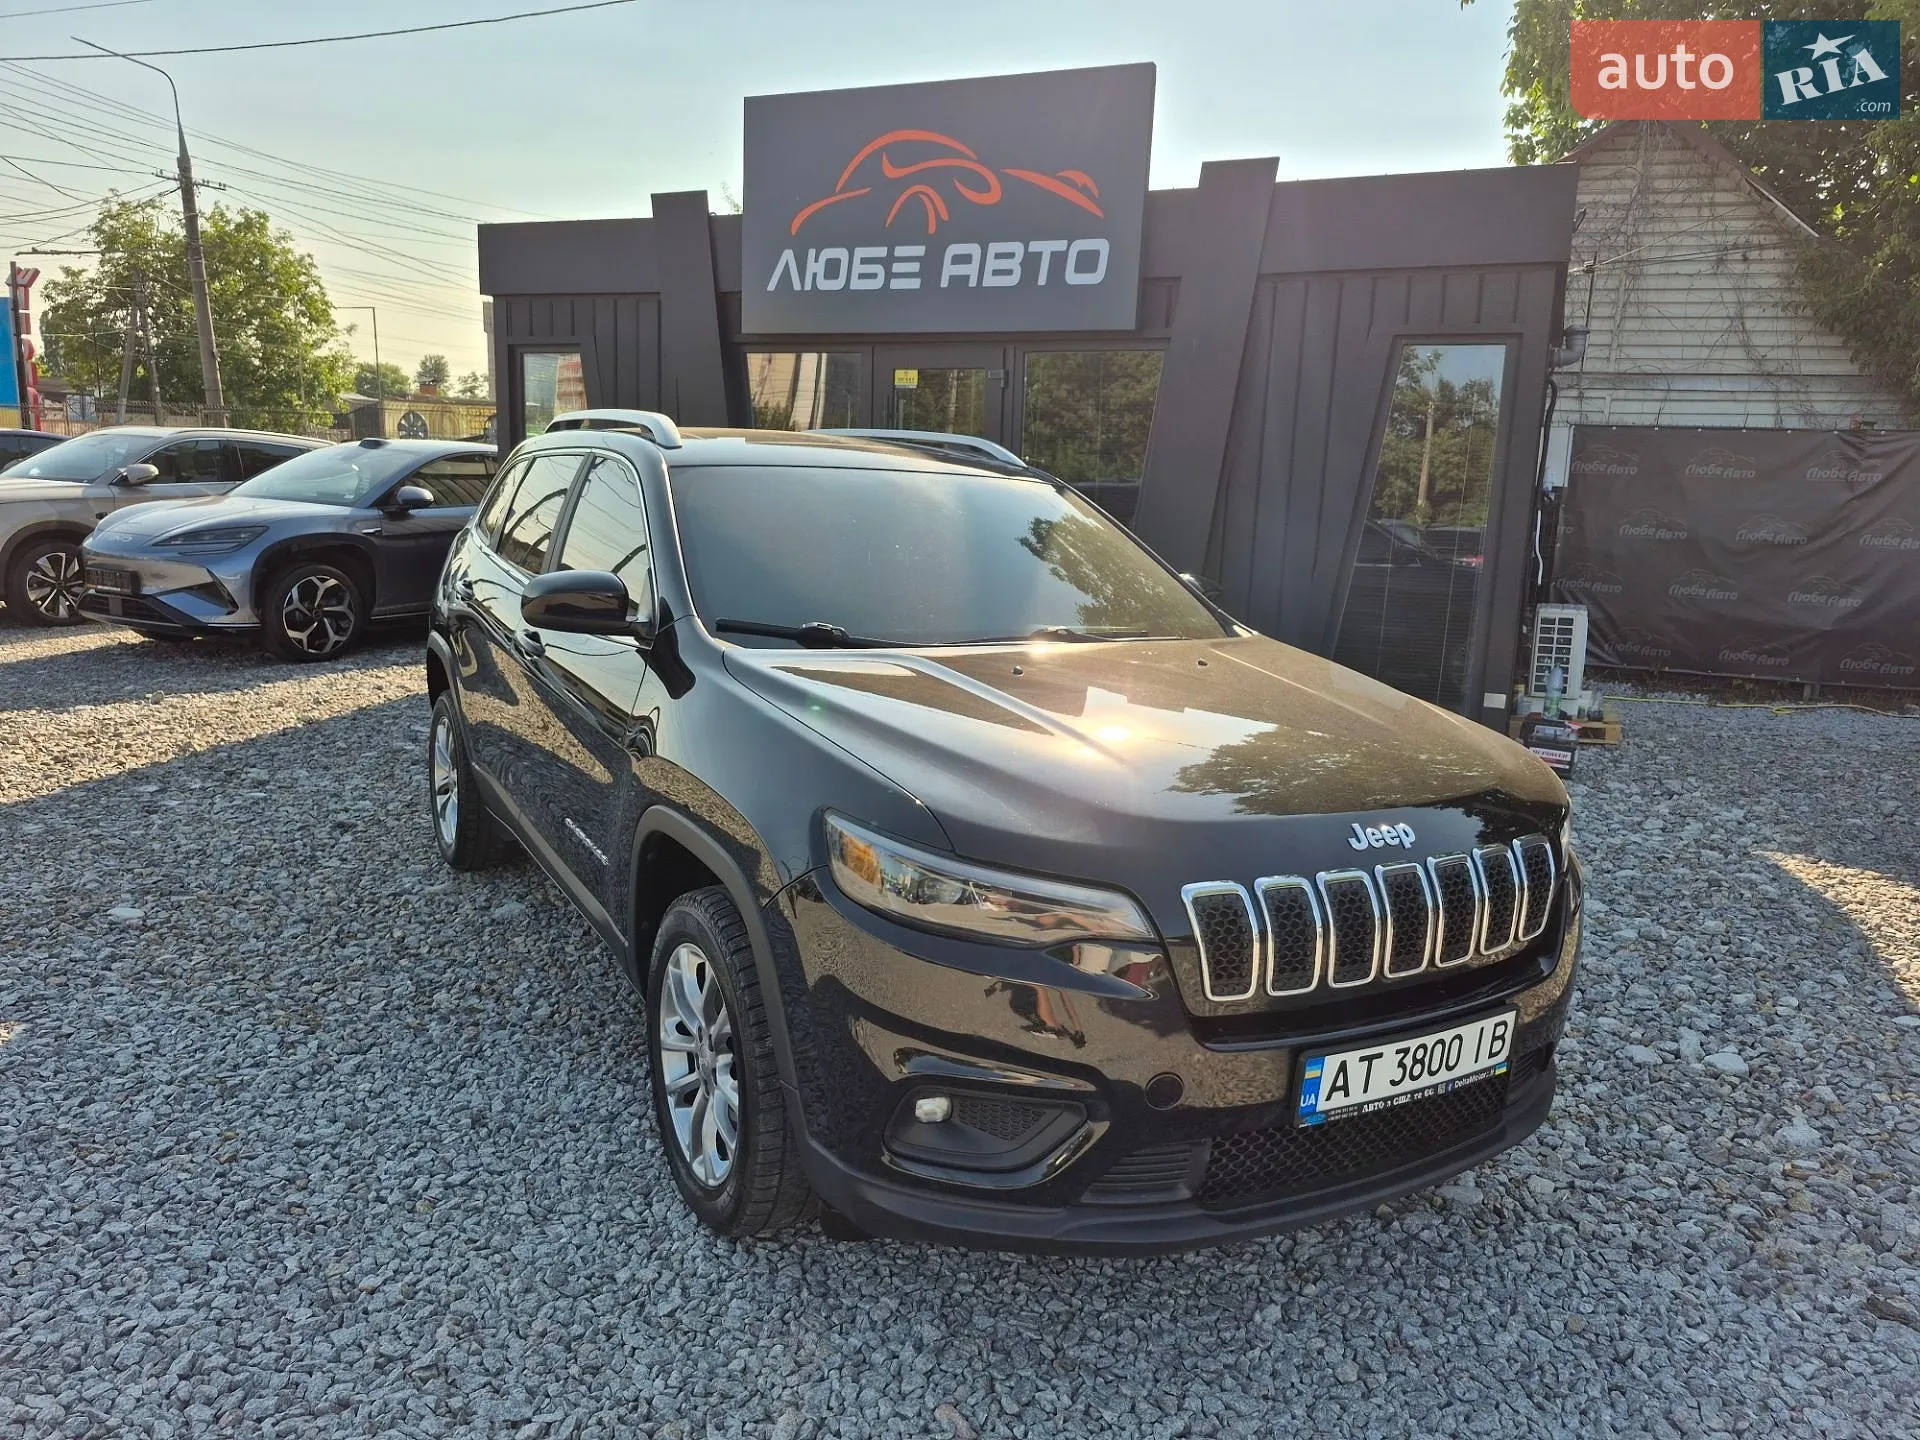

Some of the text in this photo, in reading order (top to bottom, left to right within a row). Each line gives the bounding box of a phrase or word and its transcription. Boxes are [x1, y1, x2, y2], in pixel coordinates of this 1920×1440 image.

[766, 238, 1110, 291] ЛЮБЕ АВТО
[1348, 823, 1415, 851] Jeep
[1389, 1033, 1463, 1087] 3800
[1301, 1093, 1316, 1107] UA
